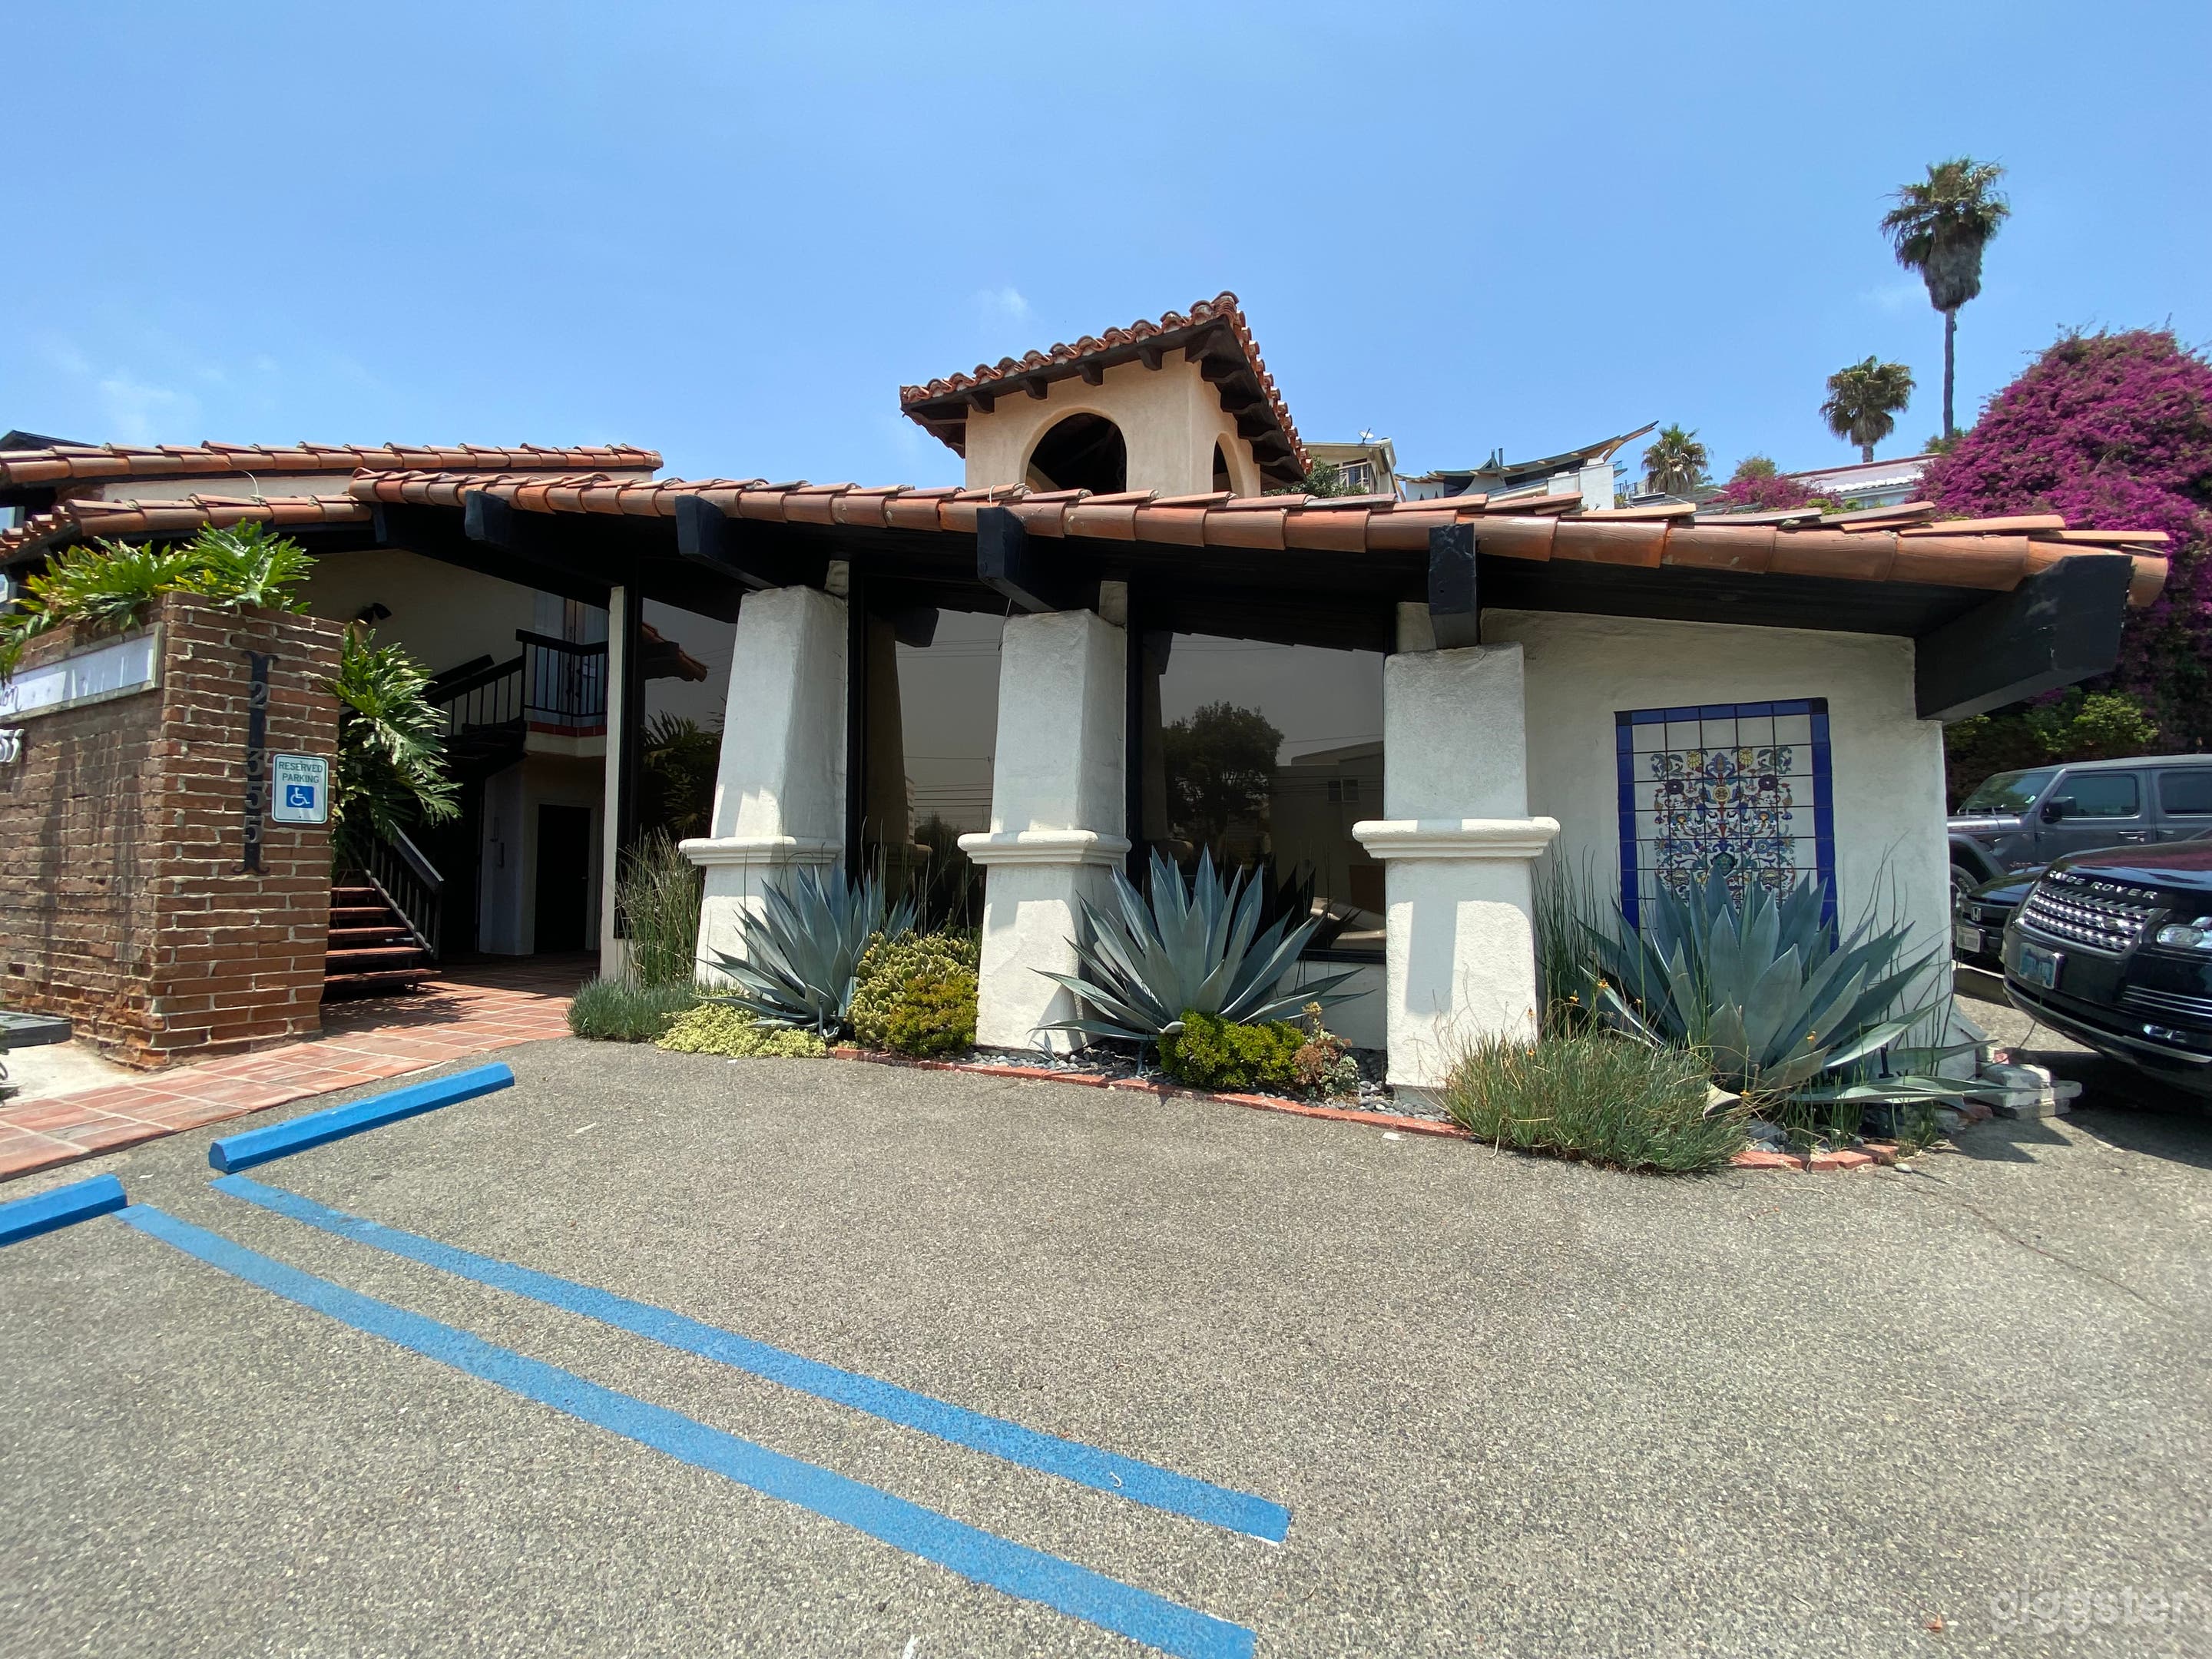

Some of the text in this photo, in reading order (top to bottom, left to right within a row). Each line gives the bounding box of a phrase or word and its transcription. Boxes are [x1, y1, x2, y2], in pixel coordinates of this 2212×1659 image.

[278, 761, 323, 773] RESERVED
[282, 773, 320, 783] PARKING
[2090, 881, 2157, 899] ROVER
